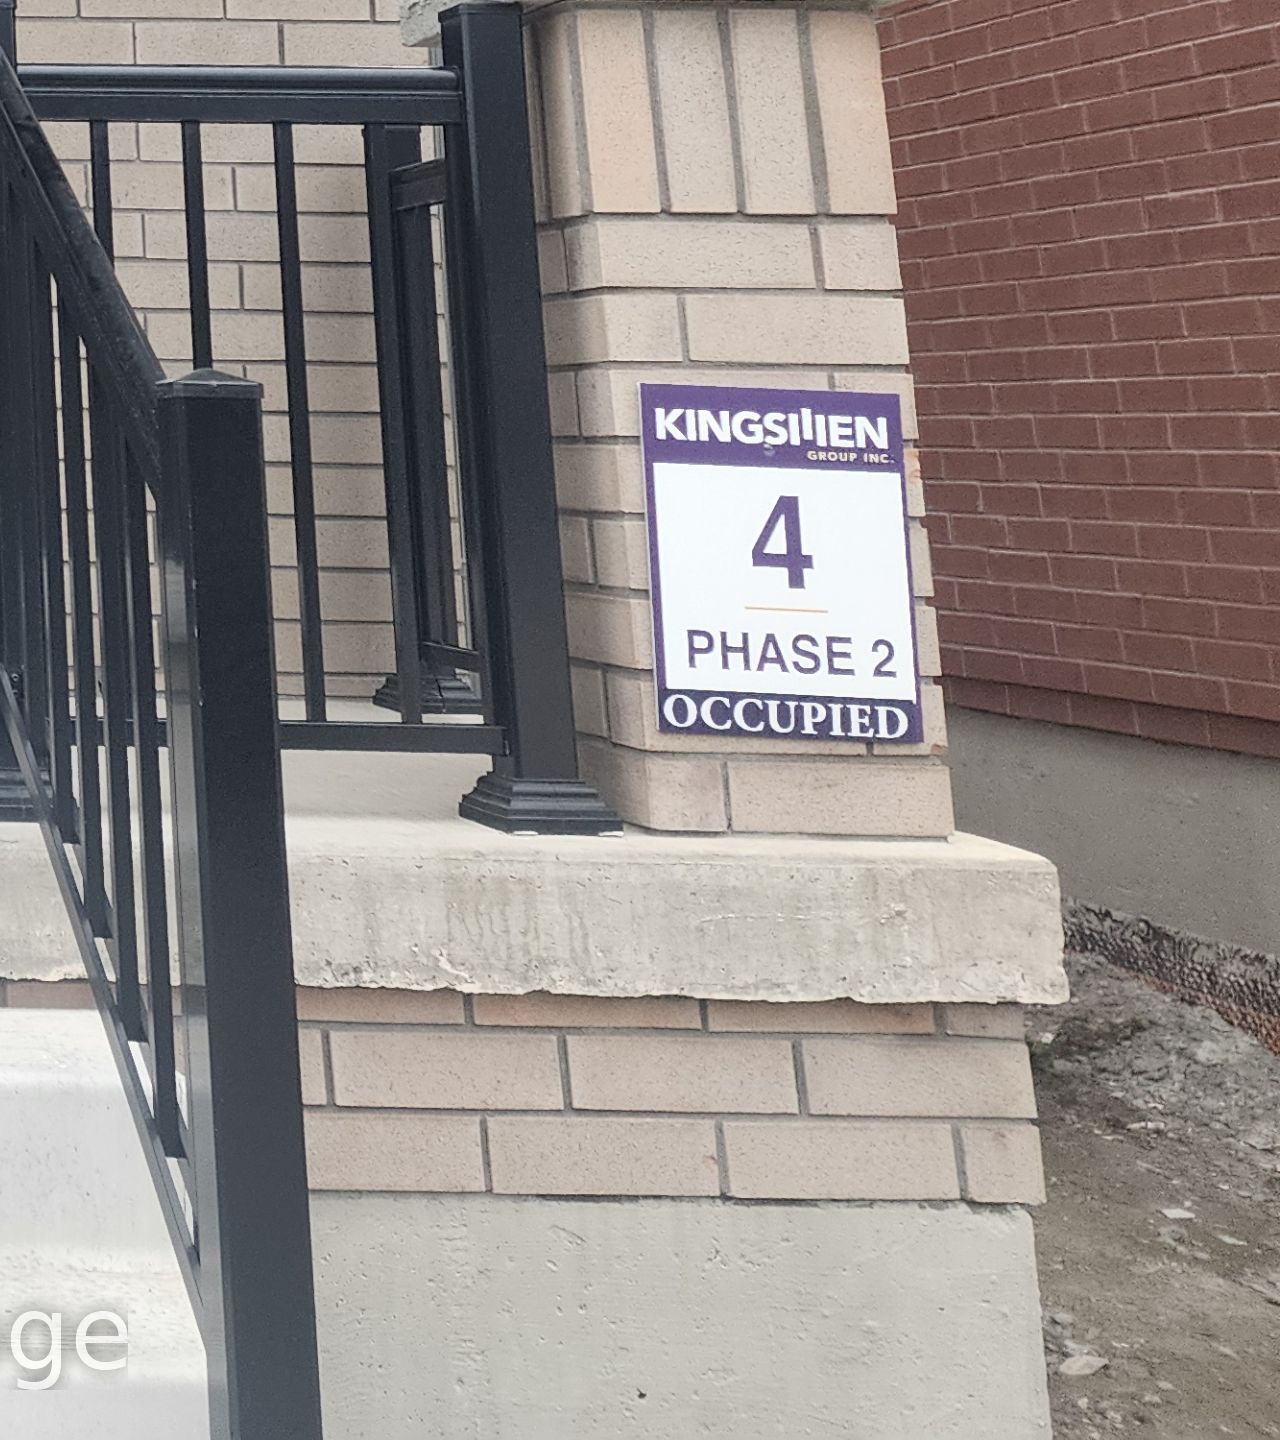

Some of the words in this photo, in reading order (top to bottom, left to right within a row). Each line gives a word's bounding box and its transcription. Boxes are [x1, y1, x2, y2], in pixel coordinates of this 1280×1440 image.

[807, 450, 858, 463] GROUP
[863, 452, 896, 464] INC.
[751, 495, 814, 589] 4
[686, 629, 856, 677] PHASE
[872, 638, 897, 679] 2
[663, 694, 909, 740] OCCUPIED
